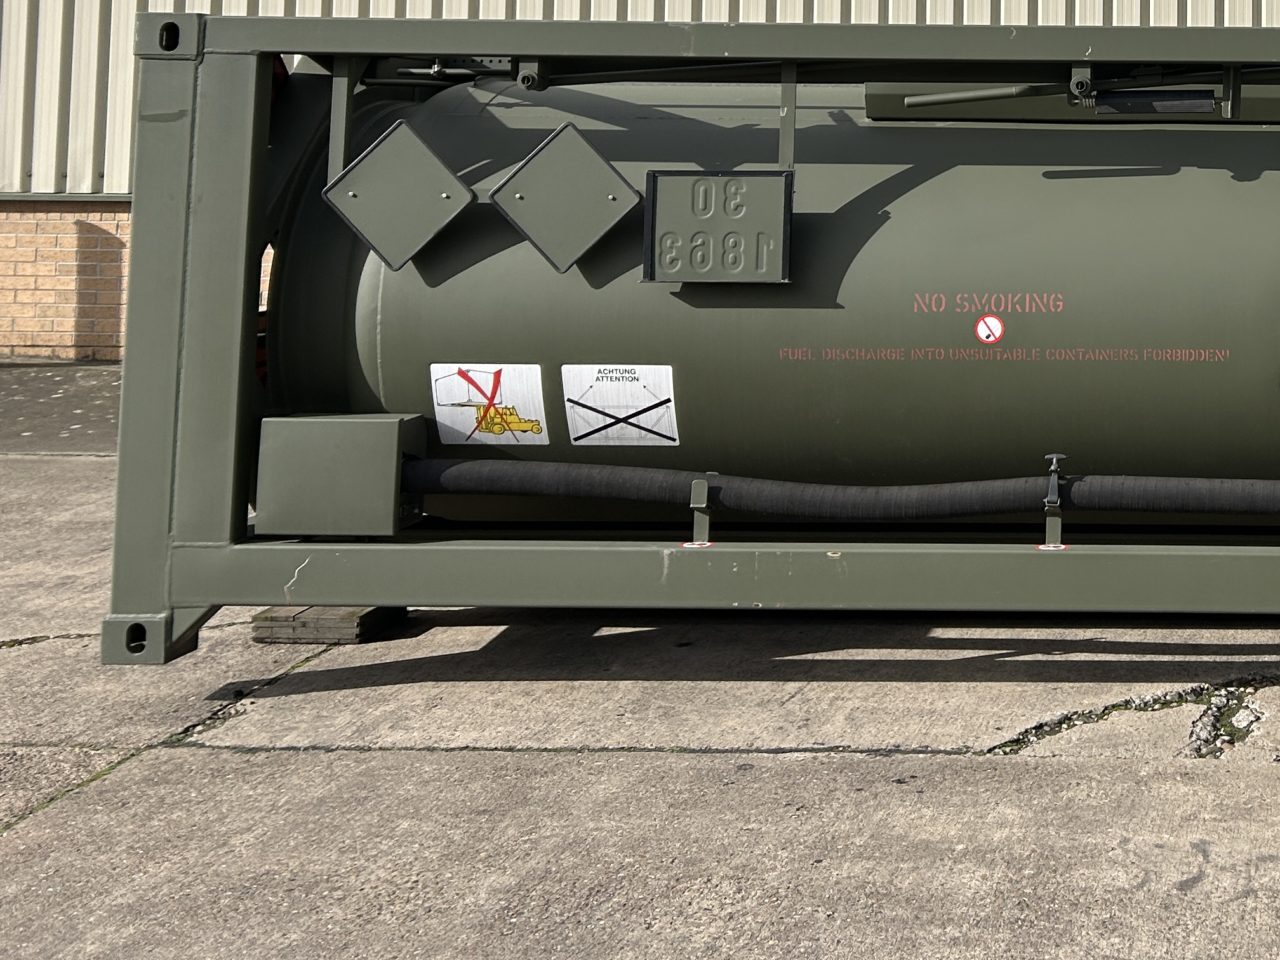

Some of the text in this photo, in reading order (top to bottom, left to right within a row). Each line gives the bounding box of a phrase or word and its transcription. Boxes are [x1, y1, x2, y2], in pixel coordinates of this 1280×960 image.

[913, 293, 1064, 313] NO SMOKING
[779, 347, 1230, 362] FUEL DISCHARGE INTO UNSUITABLE CONTAINERS FORBIDDEN!
[595, 375, 640, 383] ATTENTION
